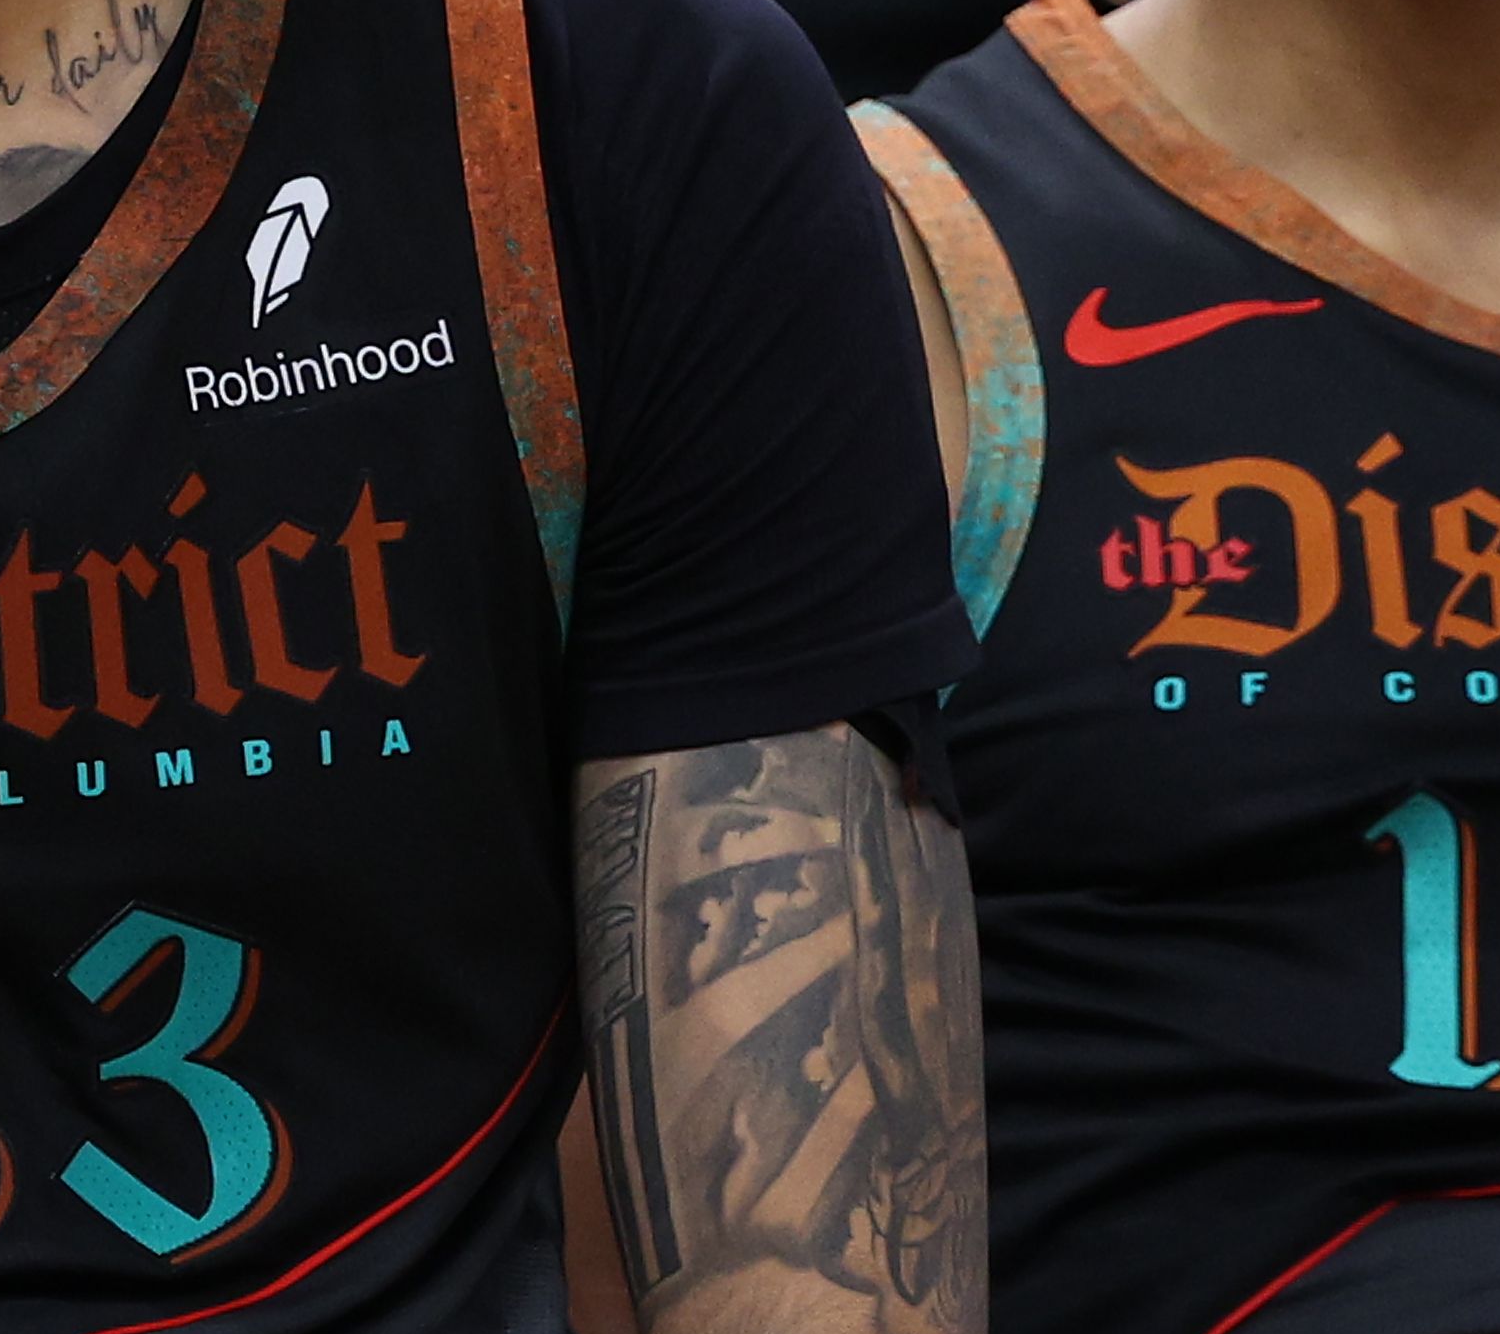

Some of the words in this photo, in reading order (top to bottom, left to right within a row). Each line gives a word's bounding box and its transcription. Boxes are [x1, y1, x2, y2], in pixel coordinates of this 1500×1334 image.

[184, 320, 455, 412] Robinhood
[1099, 516, 1255, 594] the
[1154, 671, 1268, 710] OF
